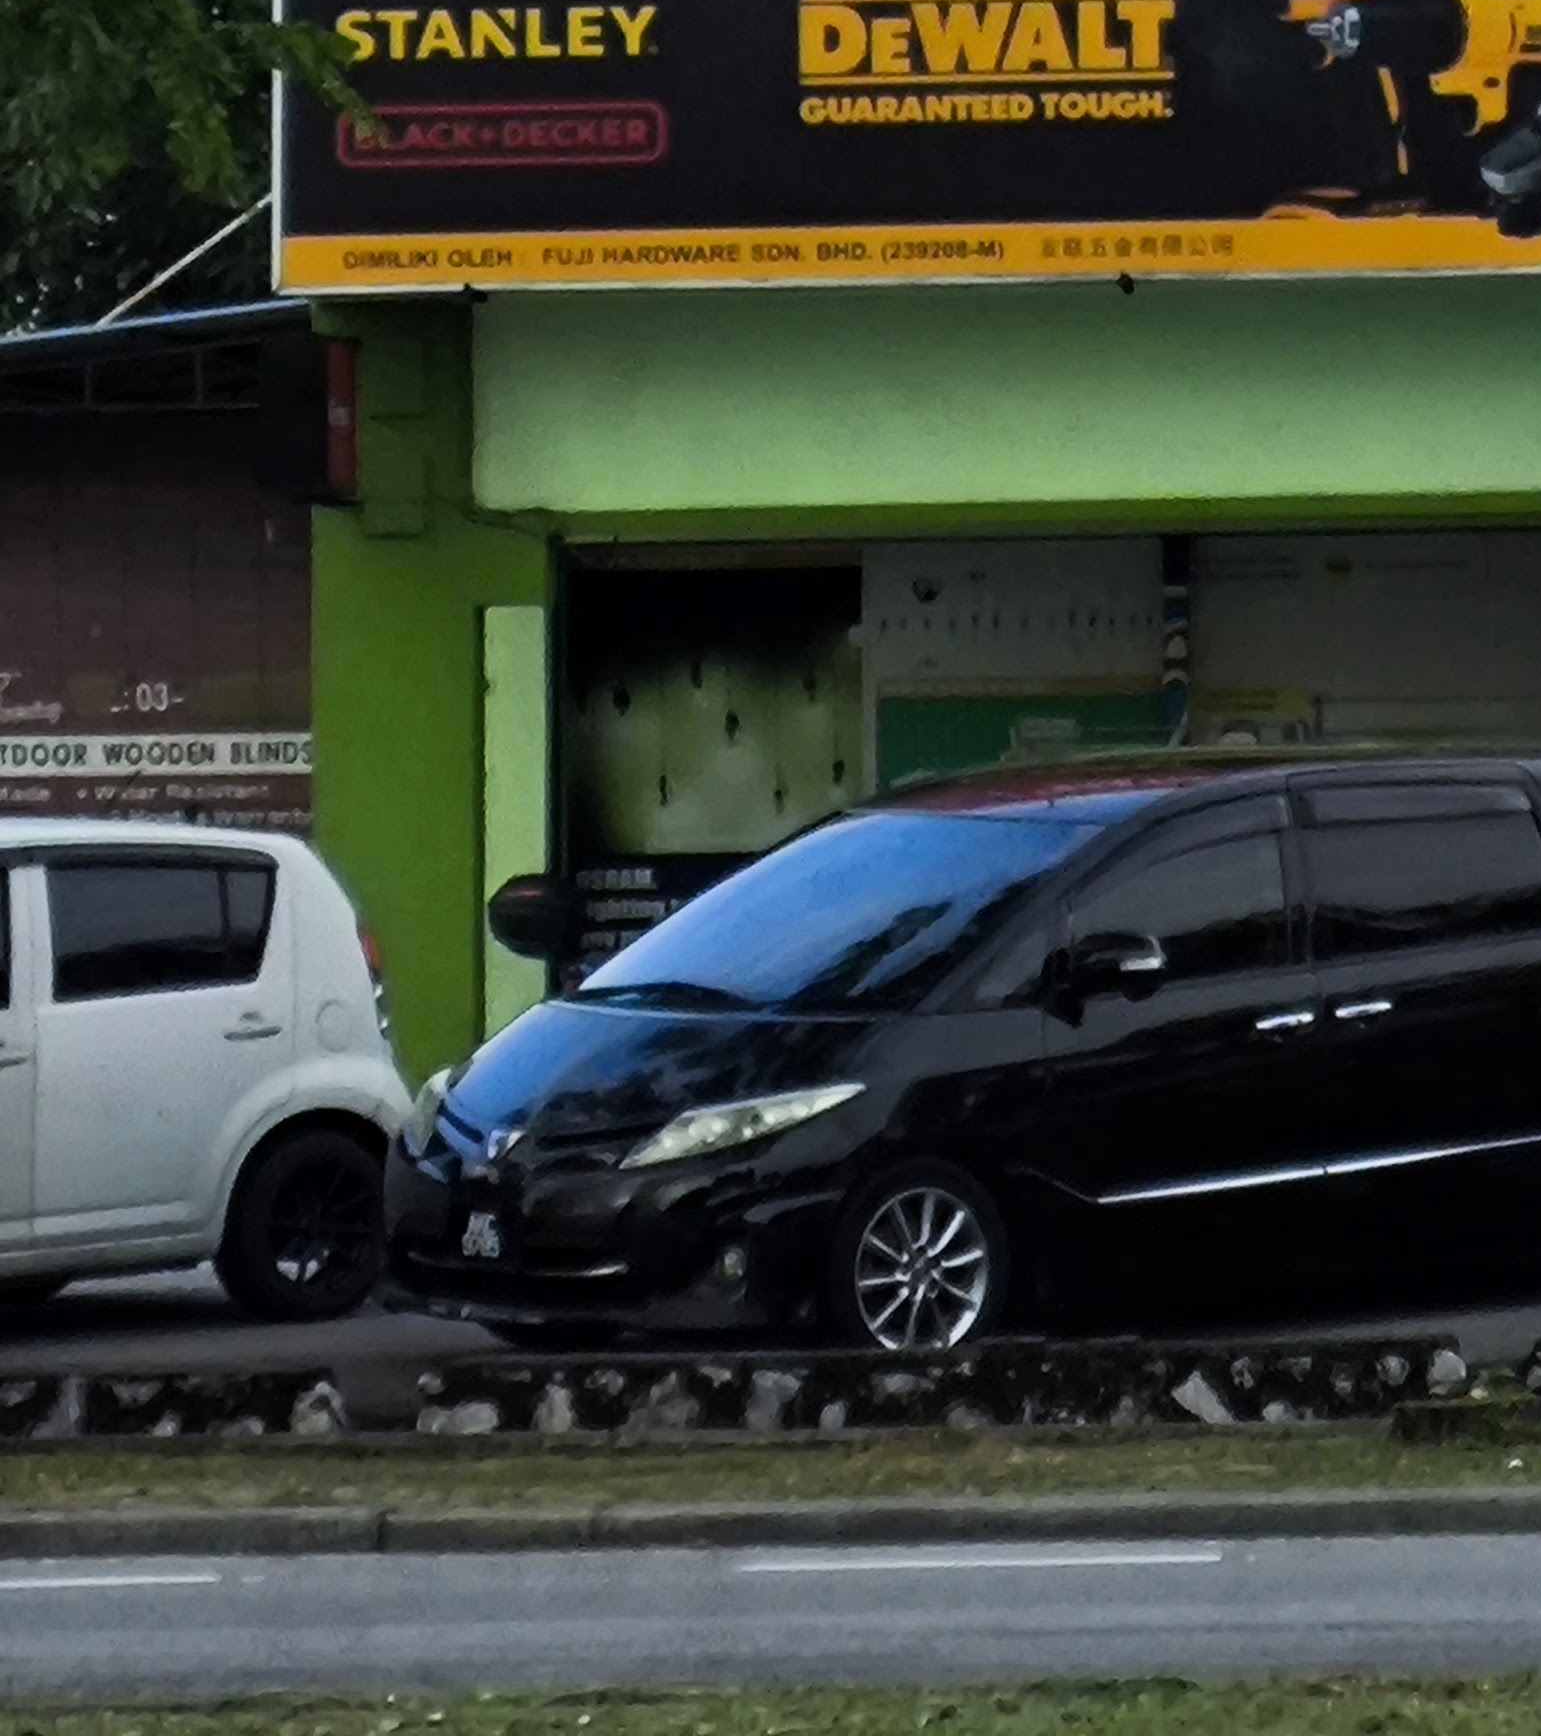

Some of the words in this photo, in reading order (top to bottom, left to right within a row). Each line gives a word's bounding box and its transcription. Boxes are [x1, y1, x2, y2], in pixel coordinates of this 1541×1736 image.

[335, 5, 657, 62] STANLEY
[800, 92, 1034, 125] GUARANTEED
[541, 245, 594, 267] FUJI
[602, 242, 739, 265] HARDWARE
[102, 741, 216, 766] WOODEN
[229, 740, 312, 765] BLINDS
